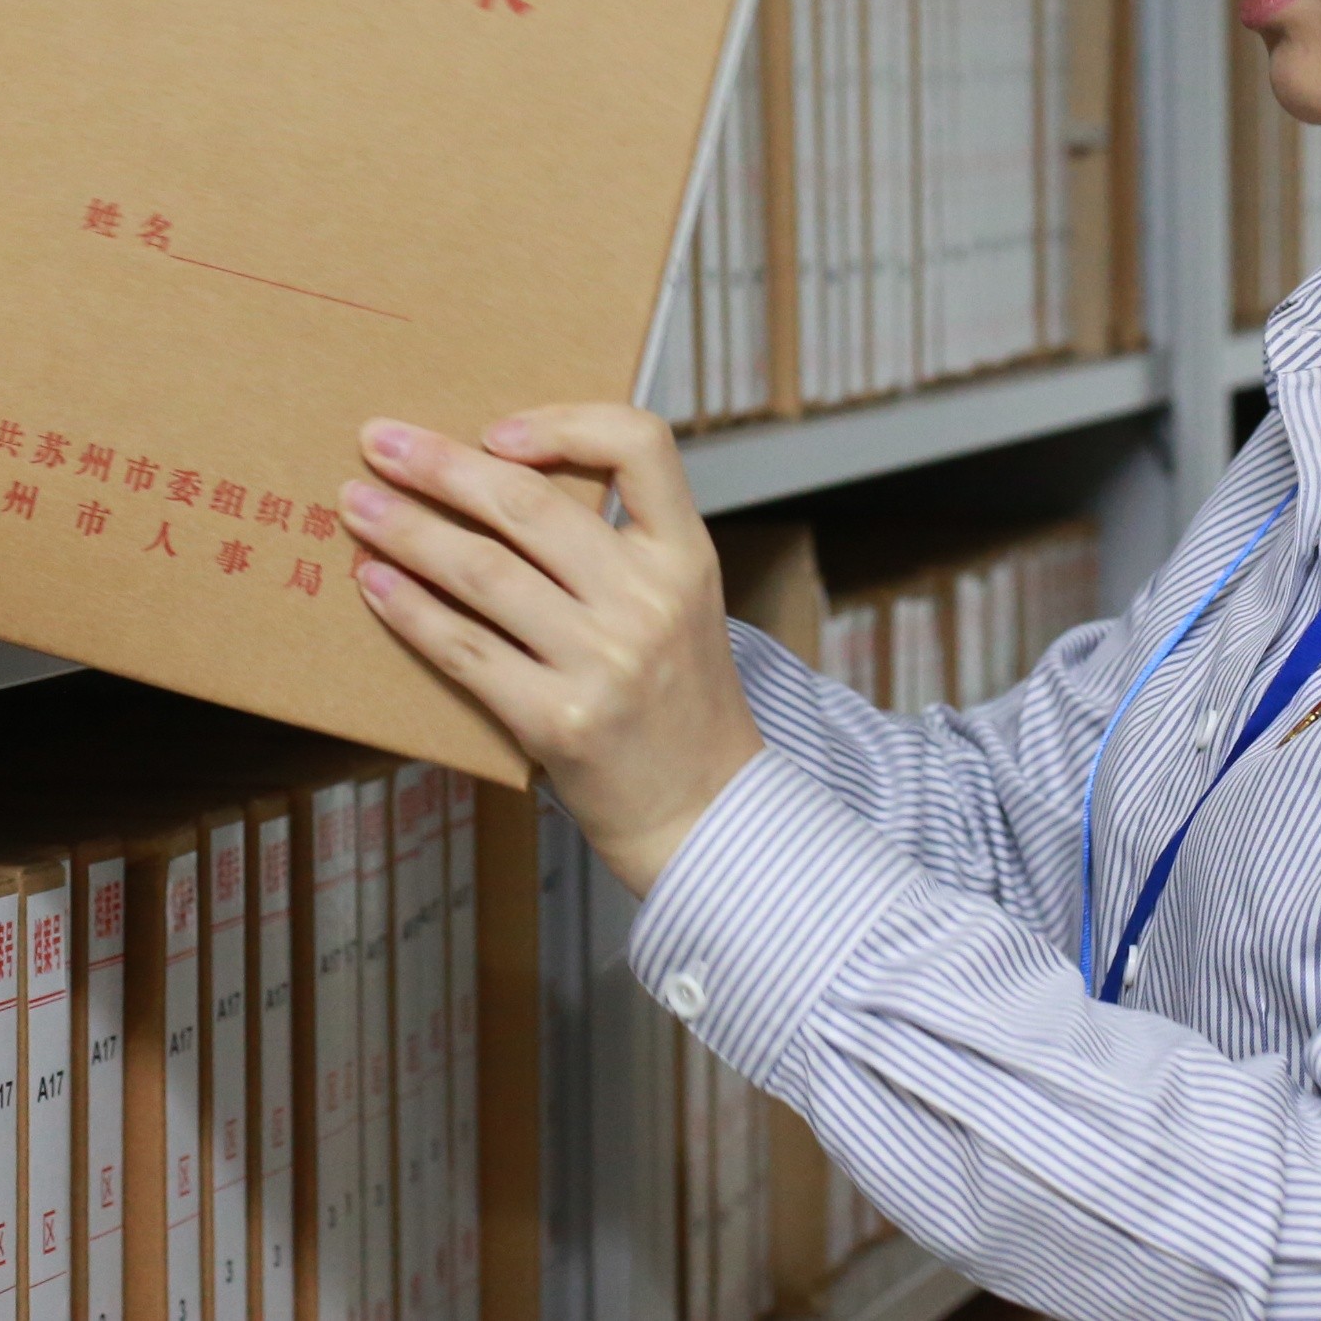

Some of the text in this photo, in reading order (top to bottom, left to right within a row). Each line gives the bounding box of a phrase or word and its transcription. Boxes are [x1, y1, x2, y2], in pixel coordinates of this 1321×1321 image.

[81, 198, 174, 253] 姓名
[34, 914, 60, 978] 档案号
[92, 1034, 117, 1066] A17
[37, 1071, 64, 1104] A17
[44, 1209, 56, 1255] 区
